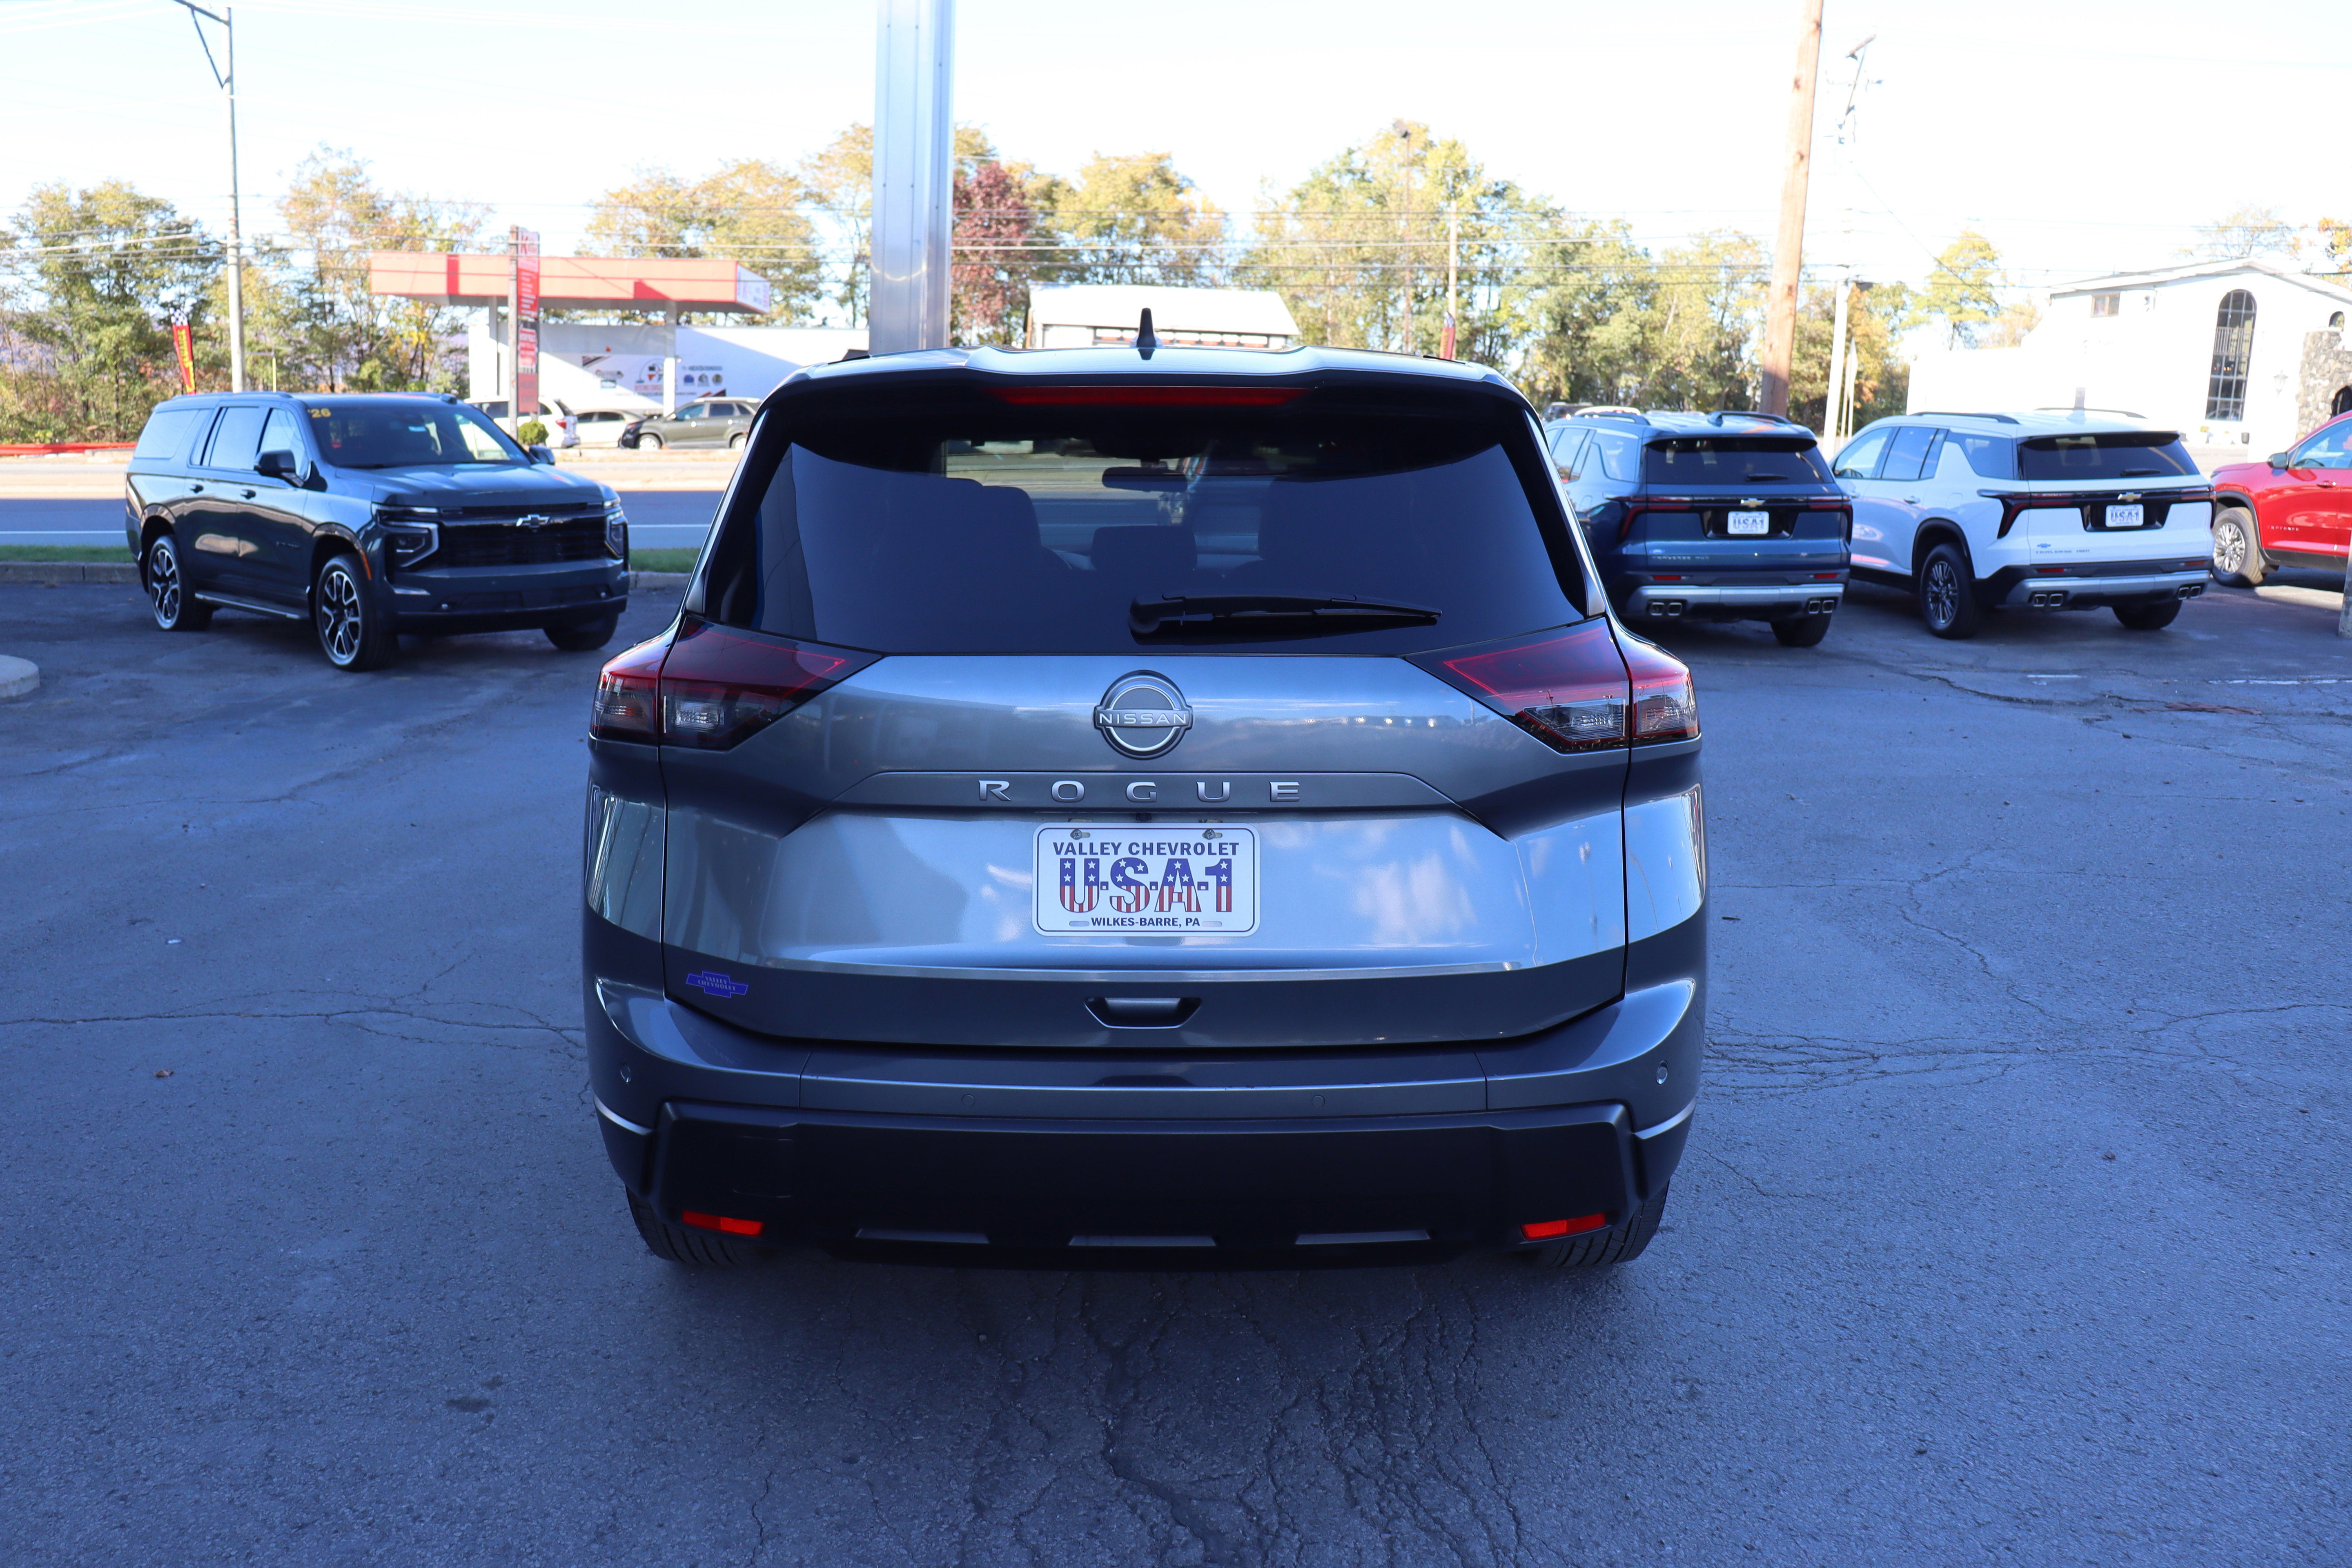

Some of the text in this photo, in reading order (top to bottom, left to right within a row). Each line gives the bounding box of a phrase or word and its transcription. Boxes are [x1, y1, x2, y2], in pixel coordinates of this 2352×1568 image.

[1099, 713, 1187, 724] NISSAN
[978, 780, 1300, 802] ROGUE
[1053, 842, 1239, 856] VALLEY CHEVROLET
[1091, 917, 1200, 928] WILKES-BARRE, PA
[697, 979, 736, 991] CHEVROLET
[705, 976, 727, 984] VALLEY
